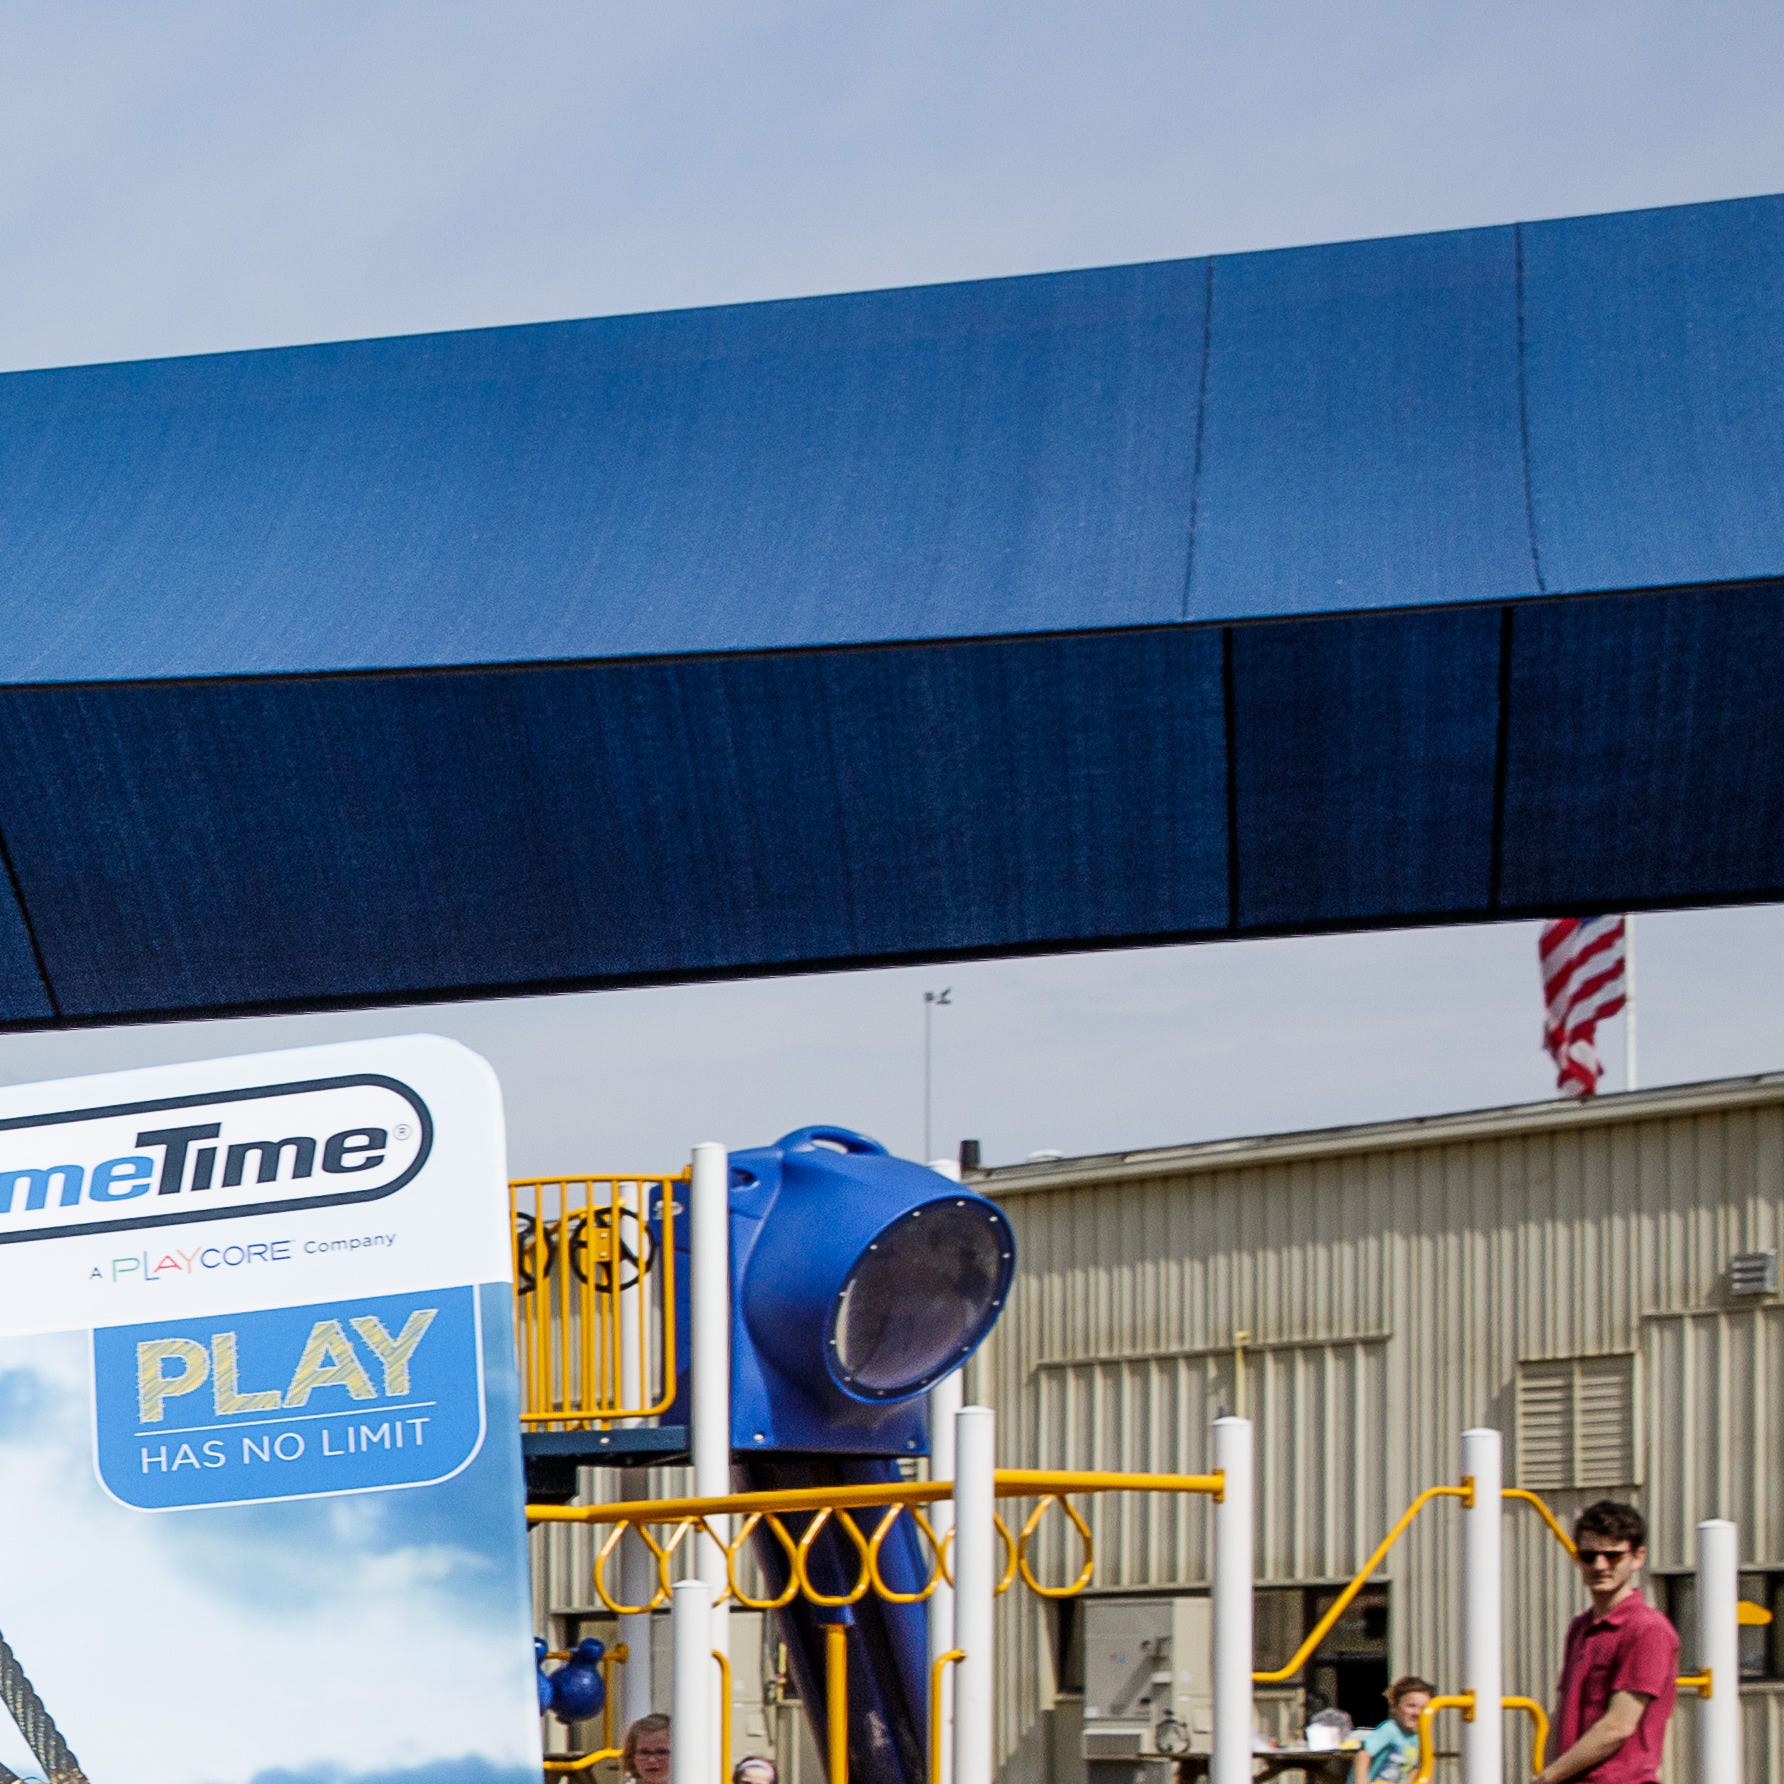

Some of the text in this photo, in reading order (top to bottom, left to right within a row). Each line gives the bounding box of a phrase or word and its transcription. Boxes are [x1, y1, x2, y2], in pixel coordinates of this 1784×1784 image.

[89, 1233, 397, 1283] A PLAYCORE Company
[136, 1308, 439, 1425] PLAY
[141, 1417, 431, 1474] HAS NO LIMIT
